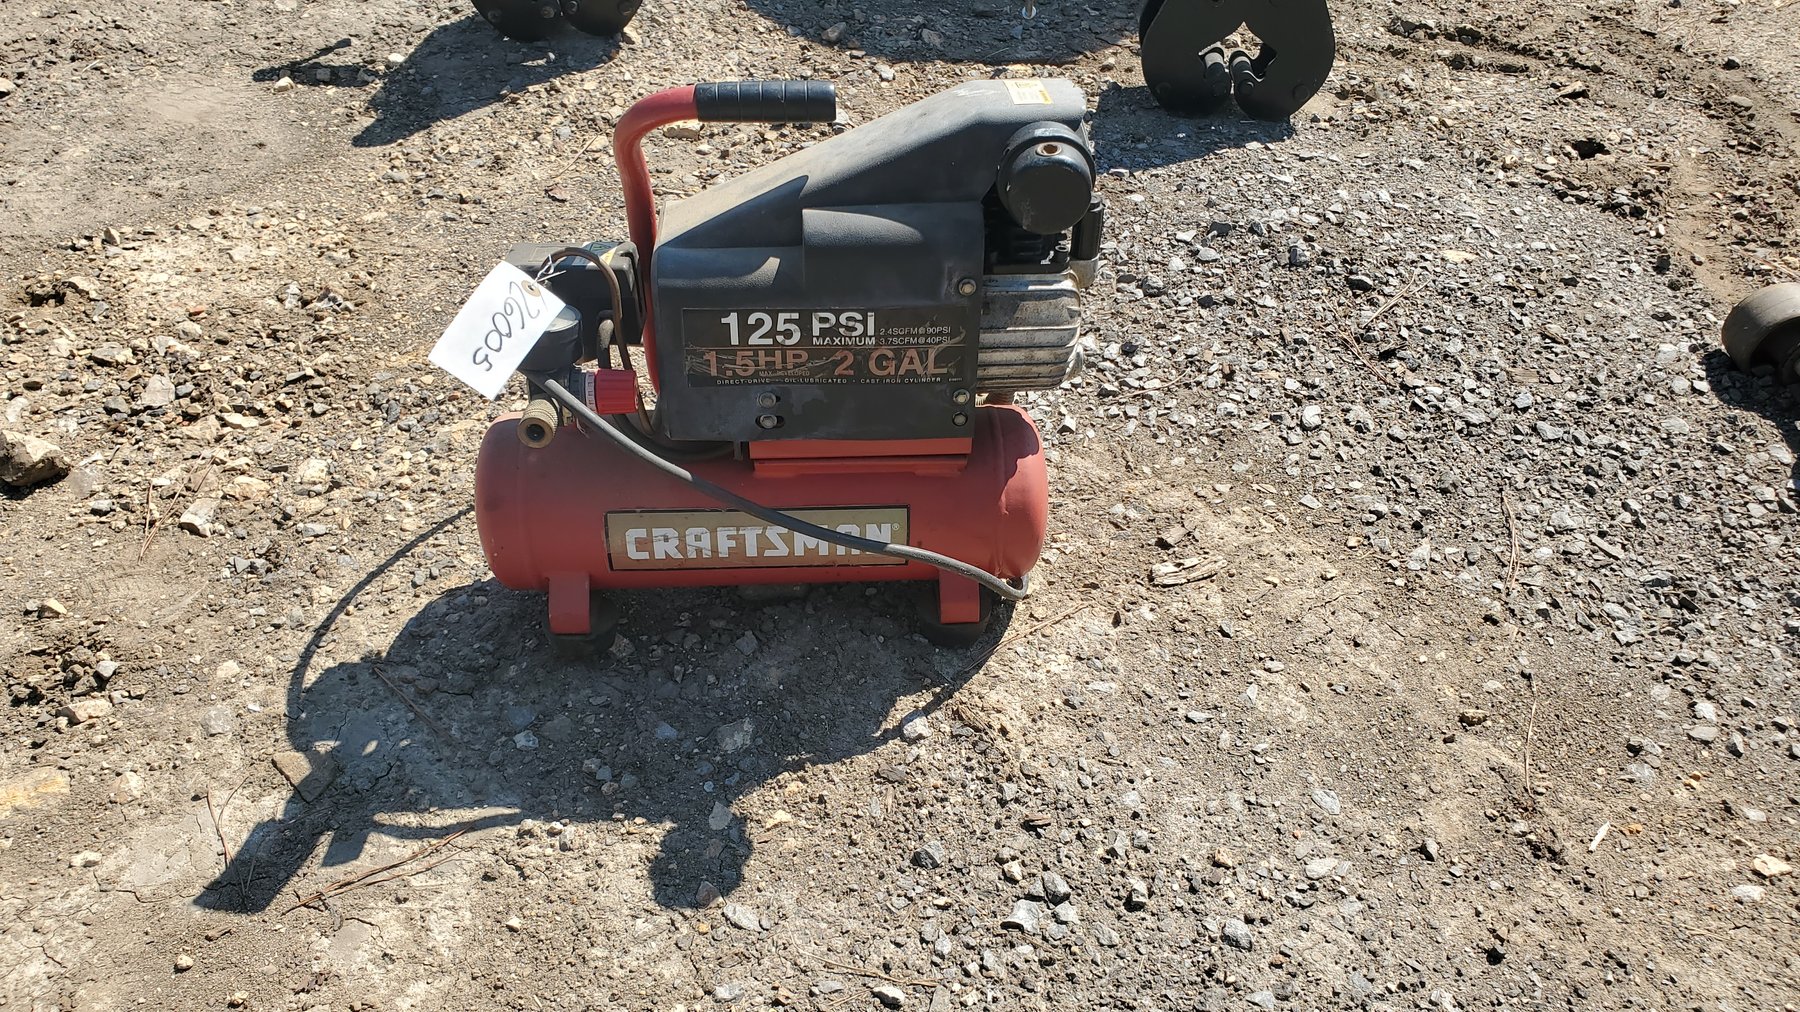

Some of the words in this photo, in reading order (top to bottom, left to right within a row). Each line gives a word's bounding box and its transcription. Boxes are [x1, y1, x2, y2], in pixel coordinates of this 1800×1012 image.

[720, 312, 801, 346] 125
[812, 311, 875, 337] PSI
[812, 336, 876, 346] MAXIMUM
[703, 349, 809, 377] 1.5HP
[834, 350, 855, 376] 2
[868, 348, 948, 377] GAL
[625, 523, 892, 560] CRAFTSMAN
